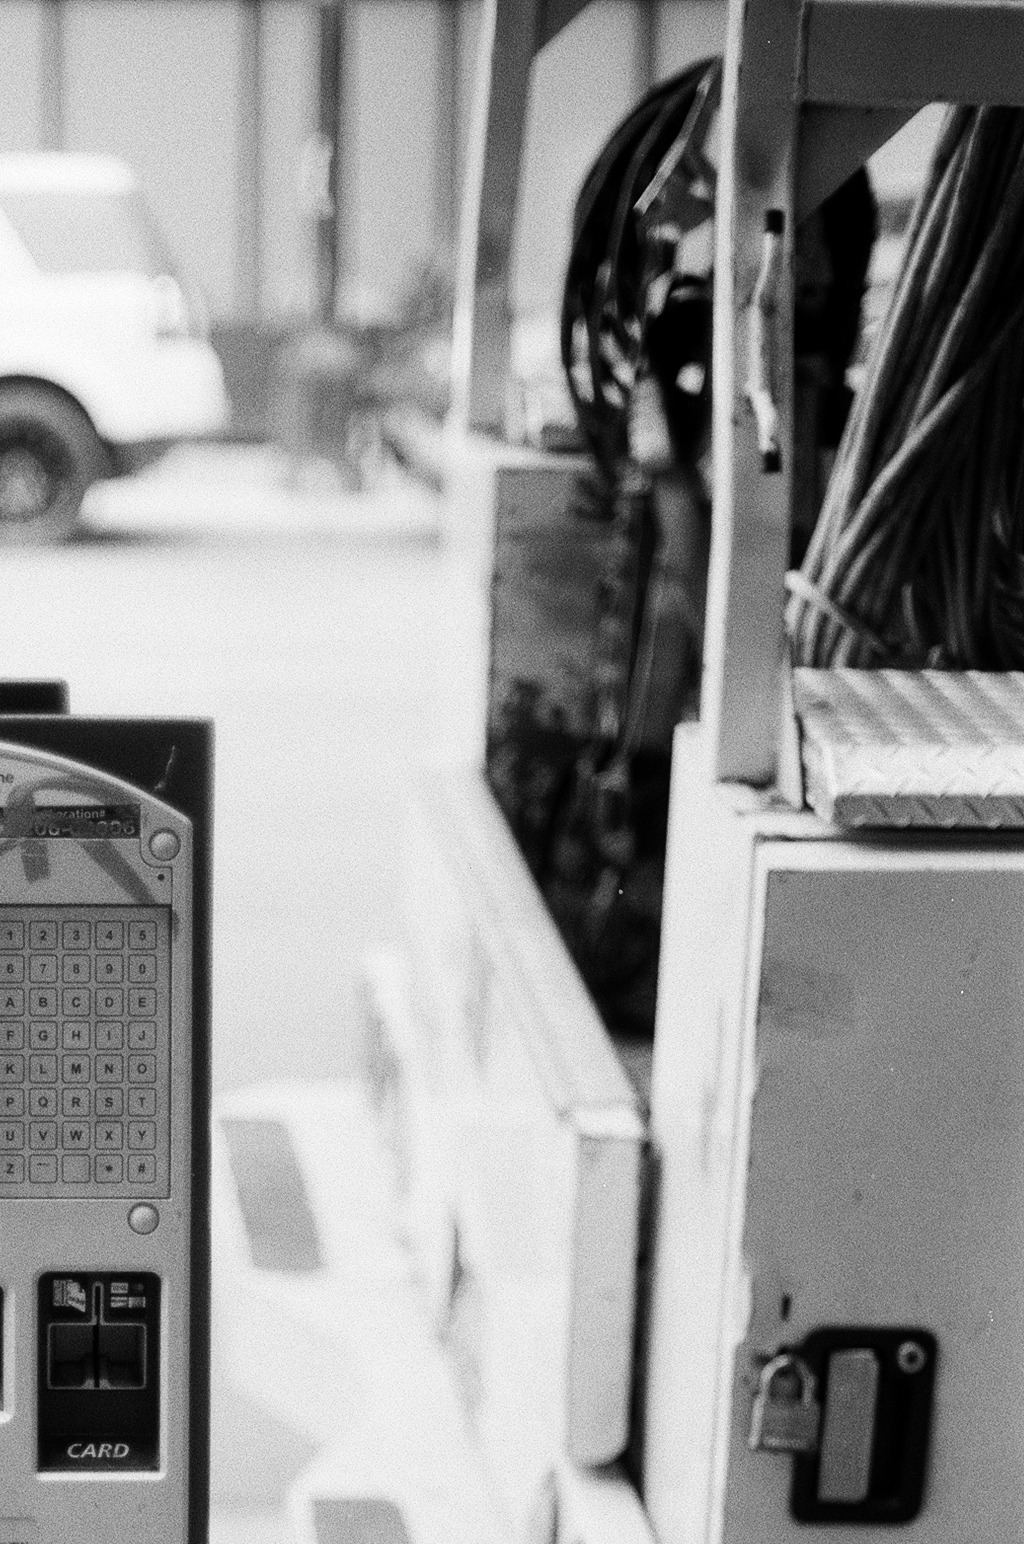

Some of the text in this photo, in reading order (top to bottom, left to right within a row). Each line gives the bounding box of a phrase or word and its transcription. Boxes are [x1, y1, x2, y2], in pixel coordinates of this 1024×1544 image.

[6, 928, 147, 942] 1 2 3 4 5
[5, 962, 15, 975] 6
[39, 962, 48, 975] 7
[72, 963, 81, 975] 8
[104, 962, 115, 975] 9
[4, 995, 147, 1009] A B C D E
[5, 1029, 15, 1042] F
[37, 1029, 49, 1042] G
[71, 1030, 82, 1041] H
[137, 1030, 147, 1042] J
[4, 1062, 148, 1075] K L M N O
[4, 1095, 146, 1109] P Q R S T
[4, 1129, 147, 1142] U V W X Y
[5, 1162, 15, 1175] Z
[67, 1443, 130, 1458] CARD
